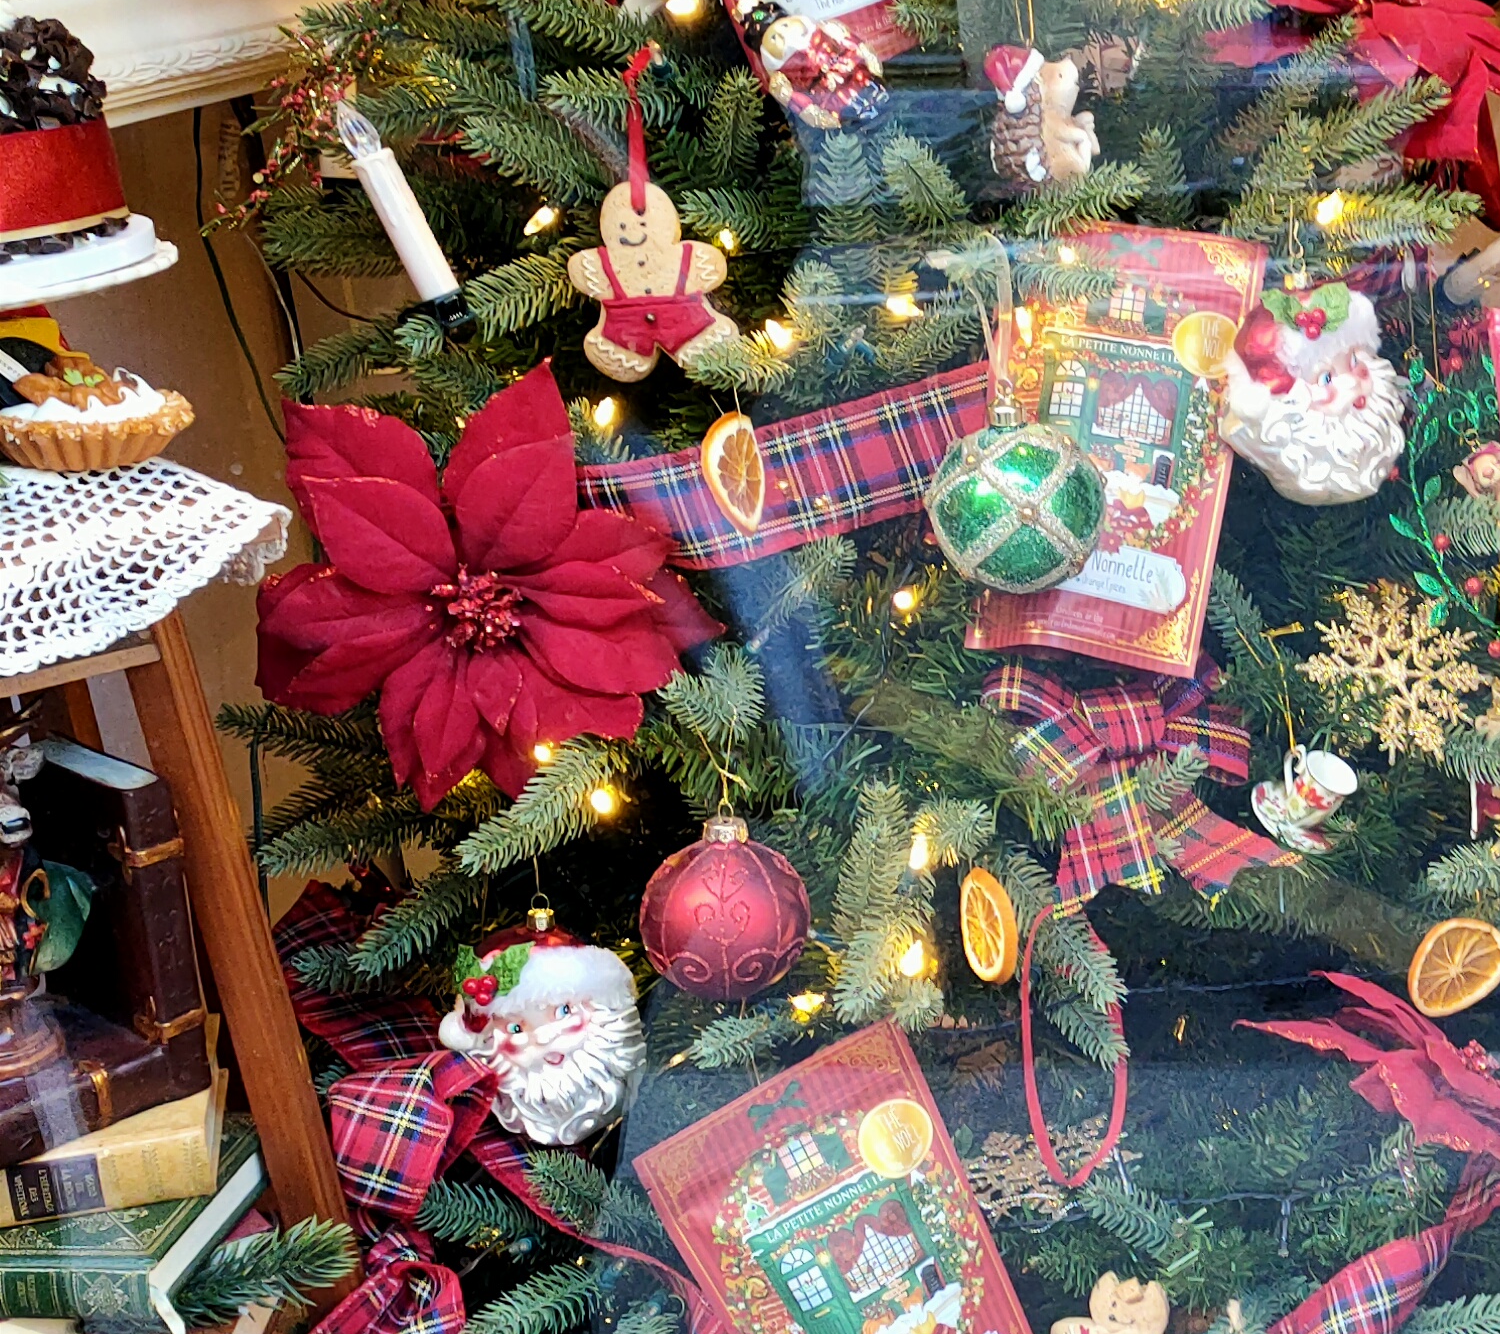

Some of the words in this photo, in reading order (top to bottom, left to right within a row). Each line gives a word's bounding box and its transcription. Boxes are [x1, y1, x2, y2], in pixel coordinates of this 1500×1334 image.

[1078, 338, 1118, 355] PETITE
[1091, 549, 1155, 585] Nonnette
[766, 1228, 783, 1244] LA
[782, 1204, 823, 1236] PETITE
